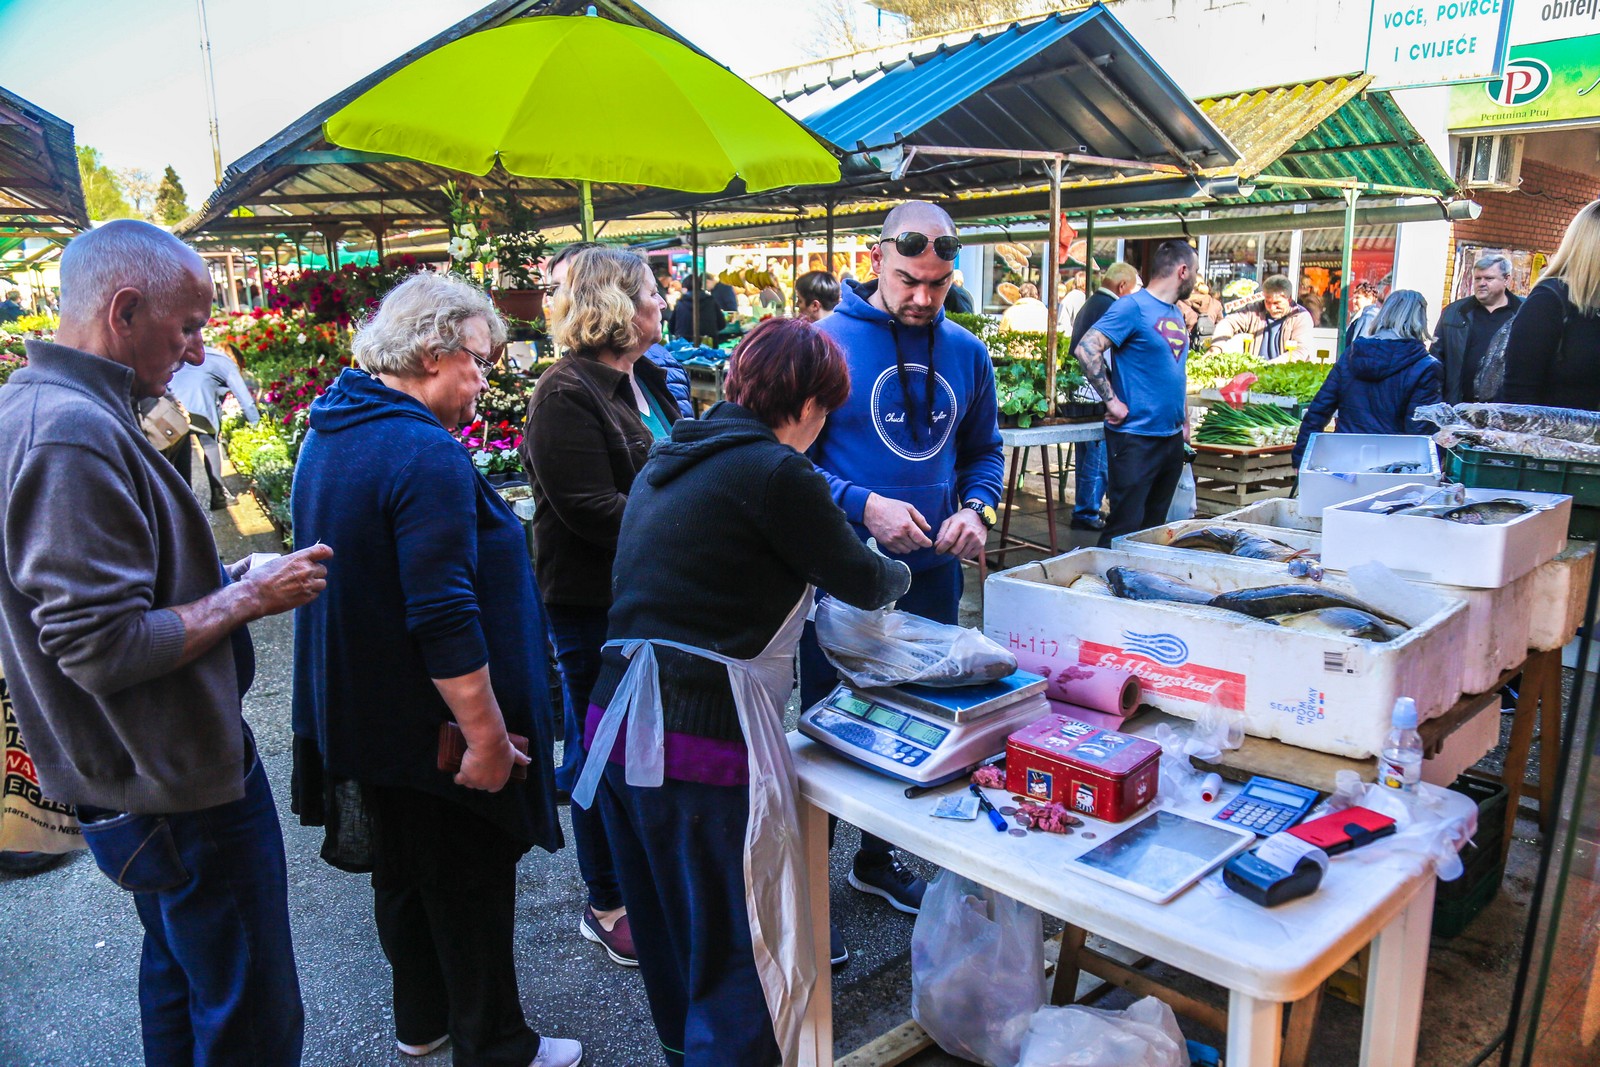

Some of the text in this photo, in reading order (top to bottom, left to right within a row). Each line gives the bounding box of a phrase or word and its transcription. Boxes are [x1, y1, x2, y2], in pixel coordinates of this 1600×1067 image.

[1384, 4, 1427, 29] VOĆE,
[1541, 0, 1600, 21] obitelj
[1394, 33, 1477, 62] I CVIJEĆE
[1481, 108, 1549, 121] Perutnina Ptuj
[885, 412, 905, 423] Chuck
[1296, 701, 1307, 726] FROM
[1306, 687, 1318, 725] NORWAY
[4, 807, 29, 819] starts
[31, 816, 49, 828] with
